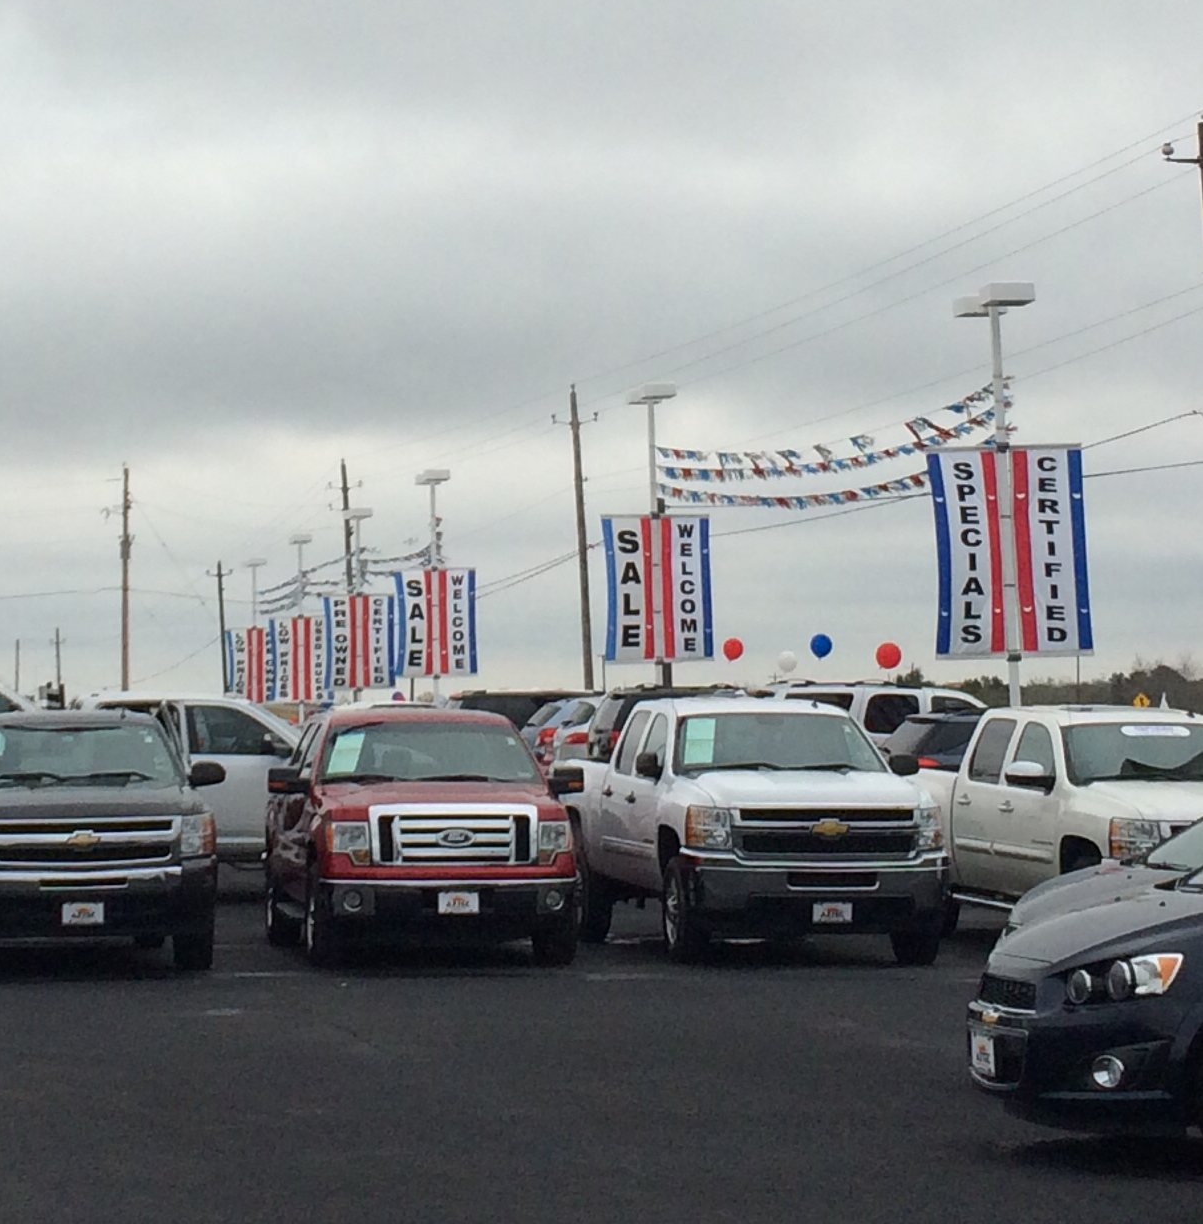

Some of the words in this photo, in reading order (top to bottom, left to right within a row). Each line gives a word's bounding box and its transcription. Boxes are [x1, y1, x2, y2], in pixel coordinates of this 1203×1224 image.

[617, 529, 642, 648] SALE
[677, 523, 697, 652] WELCOME
[952, 462, 985, 645] SPECIALS
[1037, 456, 1068, 643] CERTIFIED
[278, 621, 290, 645] LOW
[333, 599, 347, 628] PRE
[372, 598, 385, 684] CERTIFIED
[406, 579, 424, 667] SALE
[451, 575, 465, 669] WELCOME
[333, 633, 348, 687] OWNED
